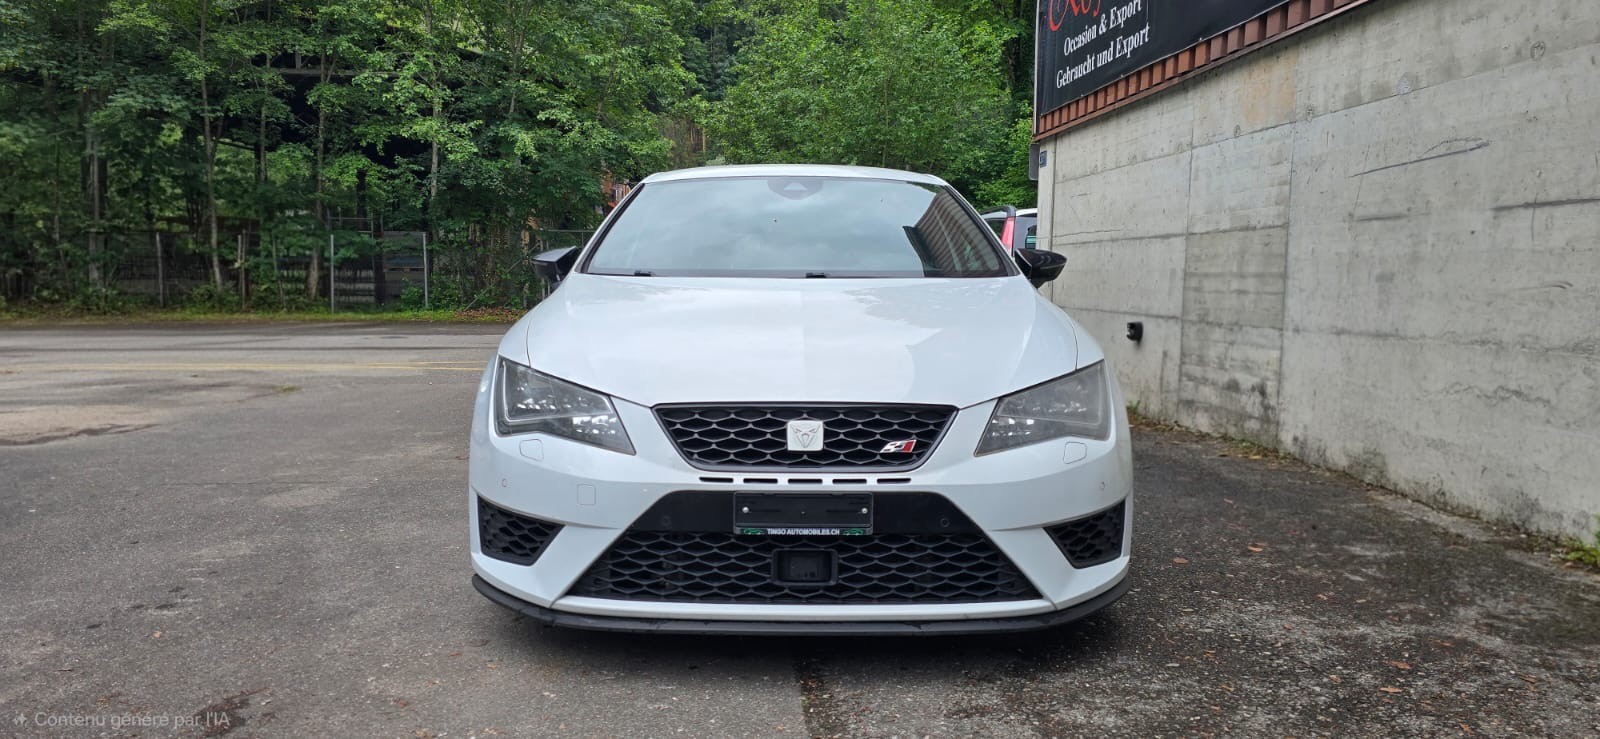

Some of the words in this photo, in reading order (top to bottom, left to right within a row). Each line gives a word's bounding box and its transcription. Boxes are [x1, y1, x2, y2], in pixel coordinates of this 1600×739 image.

[1056, 53, 1095, 89] Gebraucht
[1097, 41, 1114, 67] und
[1115, 22, 1150, 58] Export
[1063, 24, 1097, 56] Occasion
[1098, 13, 1107, 35] &
[1109, 0, 1142, 29] Export
